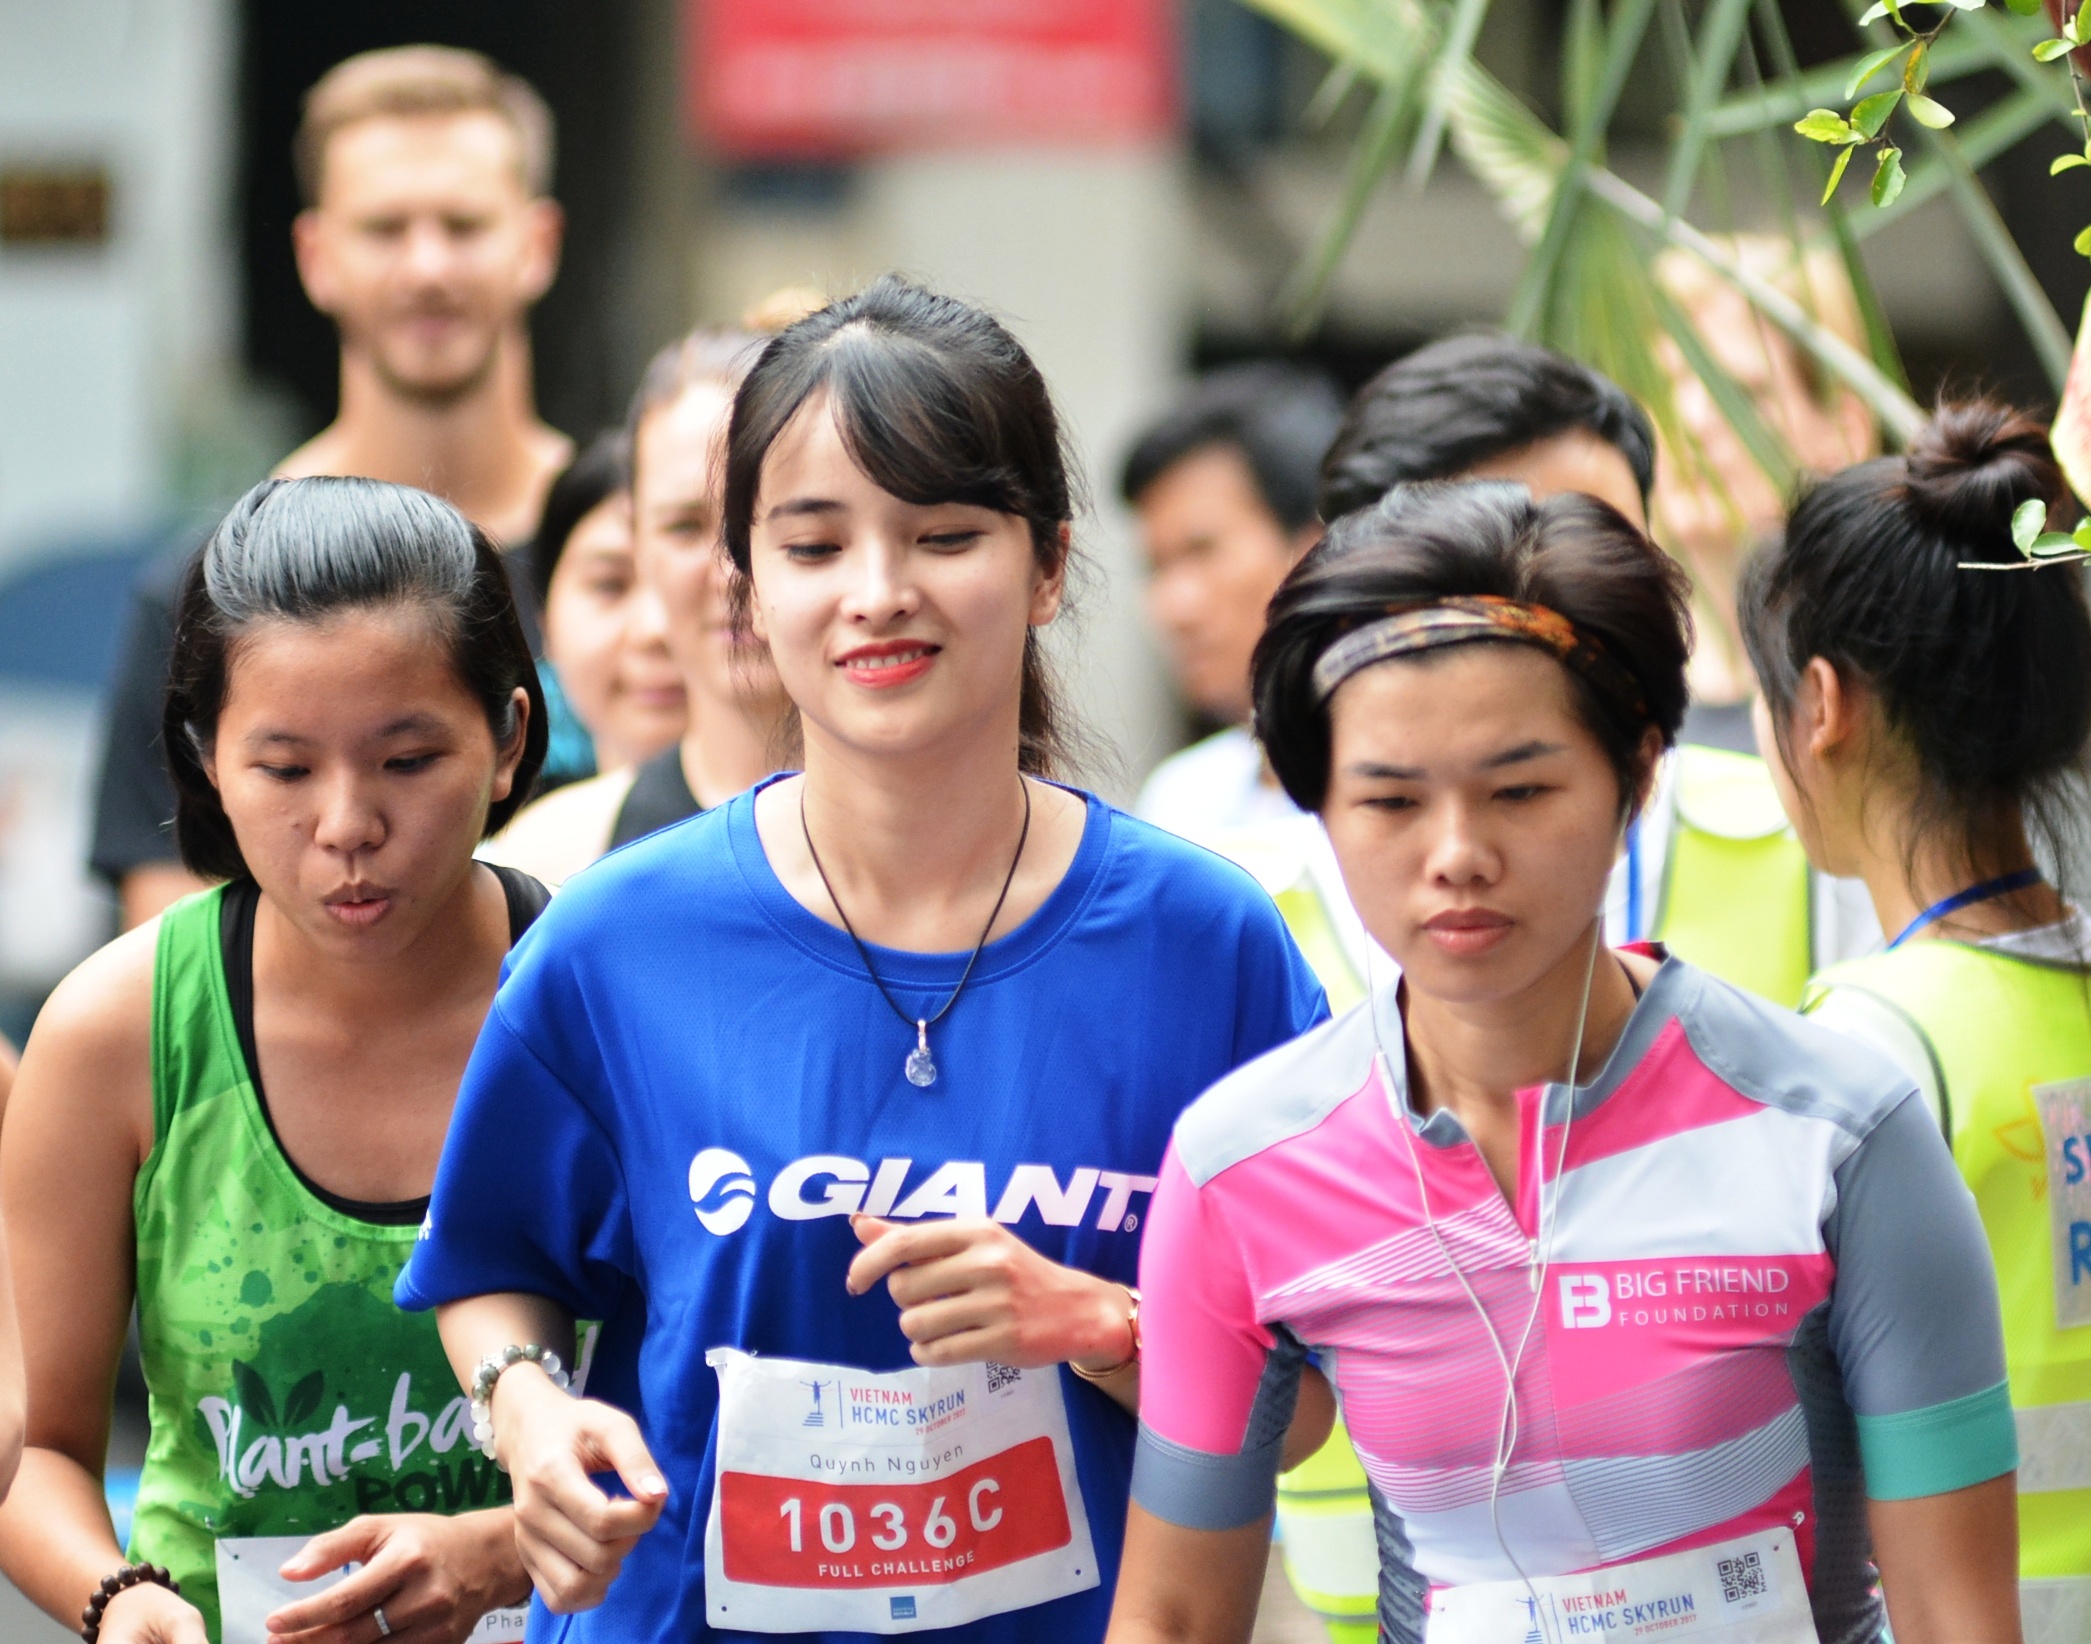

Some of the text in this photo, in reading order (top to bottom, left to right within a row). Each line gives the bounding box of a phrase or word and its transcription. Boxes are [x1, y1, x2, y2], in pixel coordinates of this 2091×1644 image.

[2063, 1135, 2091, 1184] S
[1617, 1268, 1789, 1299] BIG FRIEND
[1620, 1303, 1788, 1327] FOUNDATION
[850, 1388, 912, 1405] VIETNAM
[852, 1390, 965, 1426] HCMC SKYRUN
[810, 1445, 964, 1475] Quynh Nguyen
[780, 1478, 1003, 1553] 1036C
[818, 1550, 975, 1577] FULL CHALLENGE
[1562, 1589, 1627, 1613] VIETNAM
[1567, 1594, 1695, 1635] HCMC SKYRUN
[1634, 1614, 1697, 1636] 29 OCTOBER 2017
